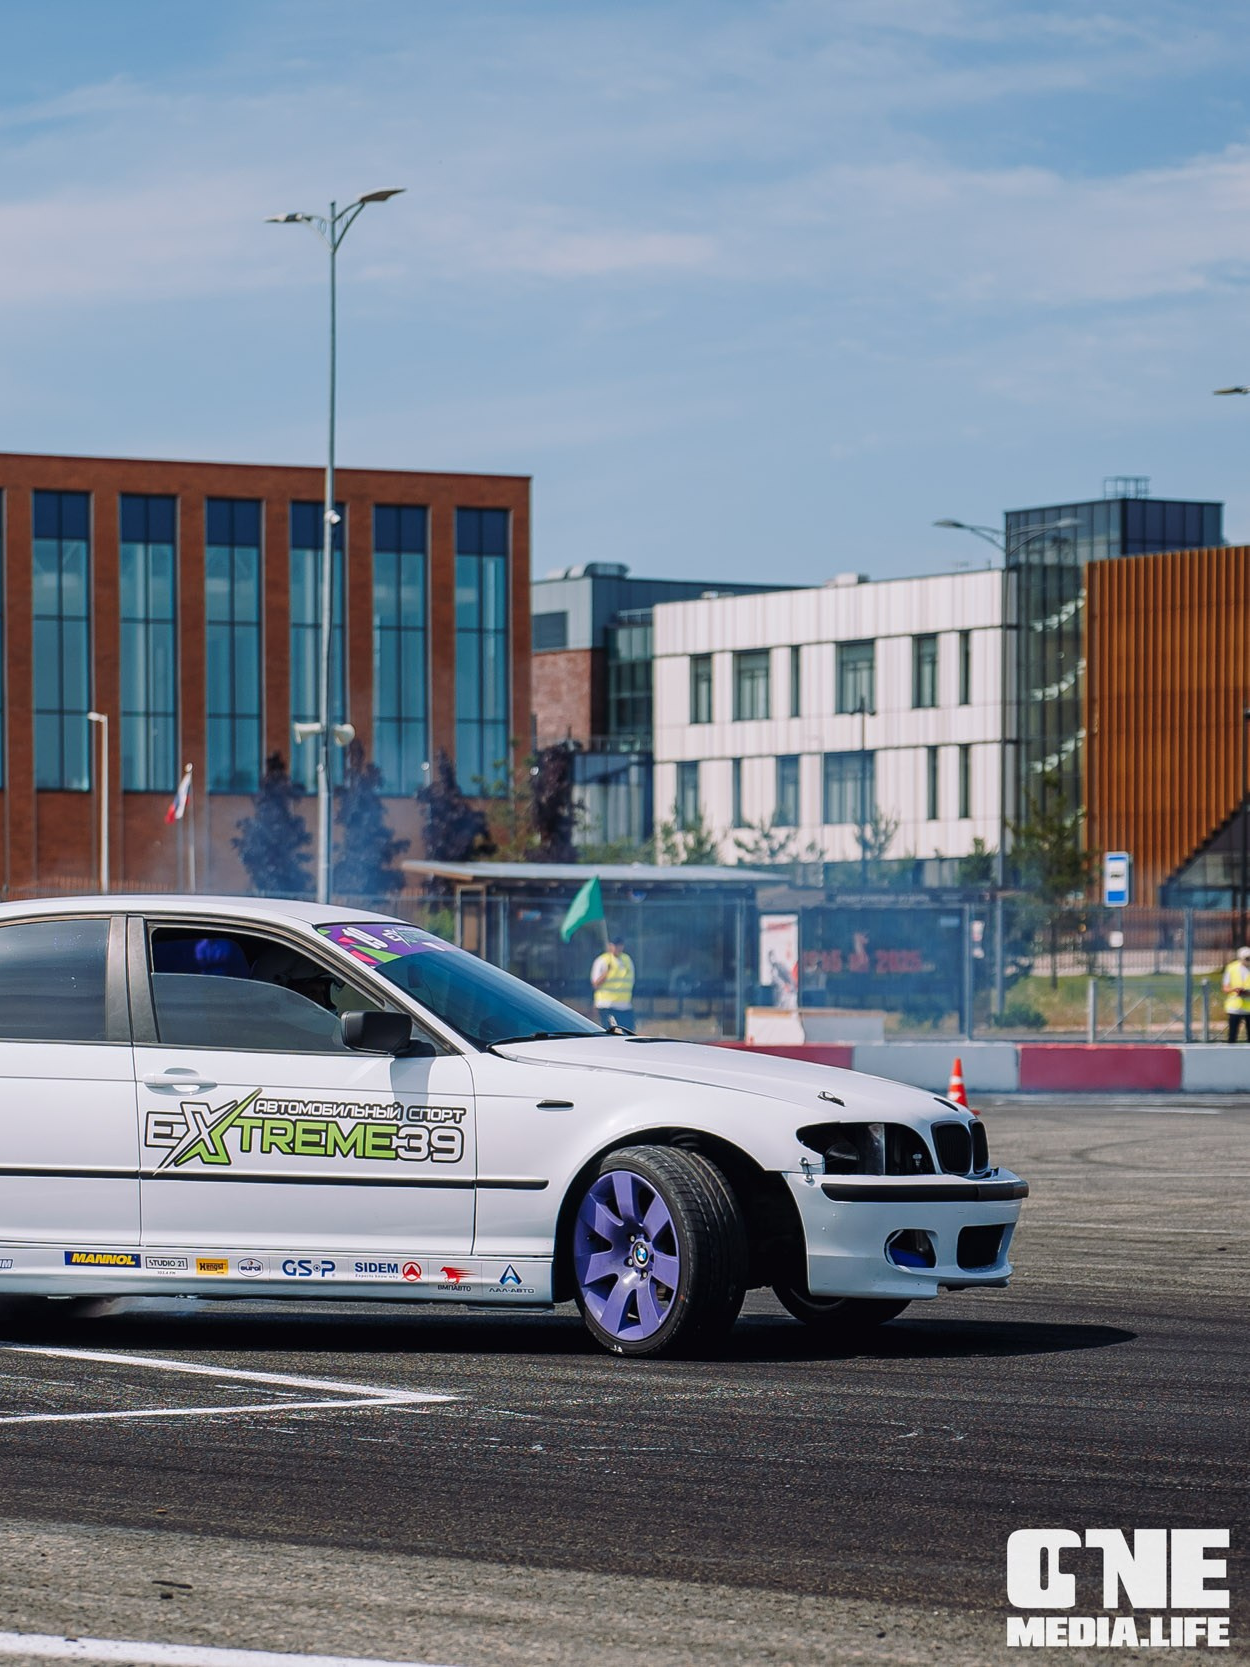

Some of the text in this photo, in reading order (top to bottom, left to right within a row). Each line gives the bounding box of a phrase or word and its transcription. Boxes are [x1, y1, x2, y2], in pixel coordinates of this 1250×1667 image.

[254, 1098, 466, 1124] АВТОМОБИЛЬНЫЙ СПОРТ
[144, 1088, 466, 1176] EXTREME39
[71, 1252, 136, 1266] MANNOL
[149, 1259, 185, 1268] STUDIO 21
[199, 1262, 225, 1271] Hengst
[354, 1261, 399, 1274] SIDEM
[437, 1284, 472, 1292] ВМПАВТО
